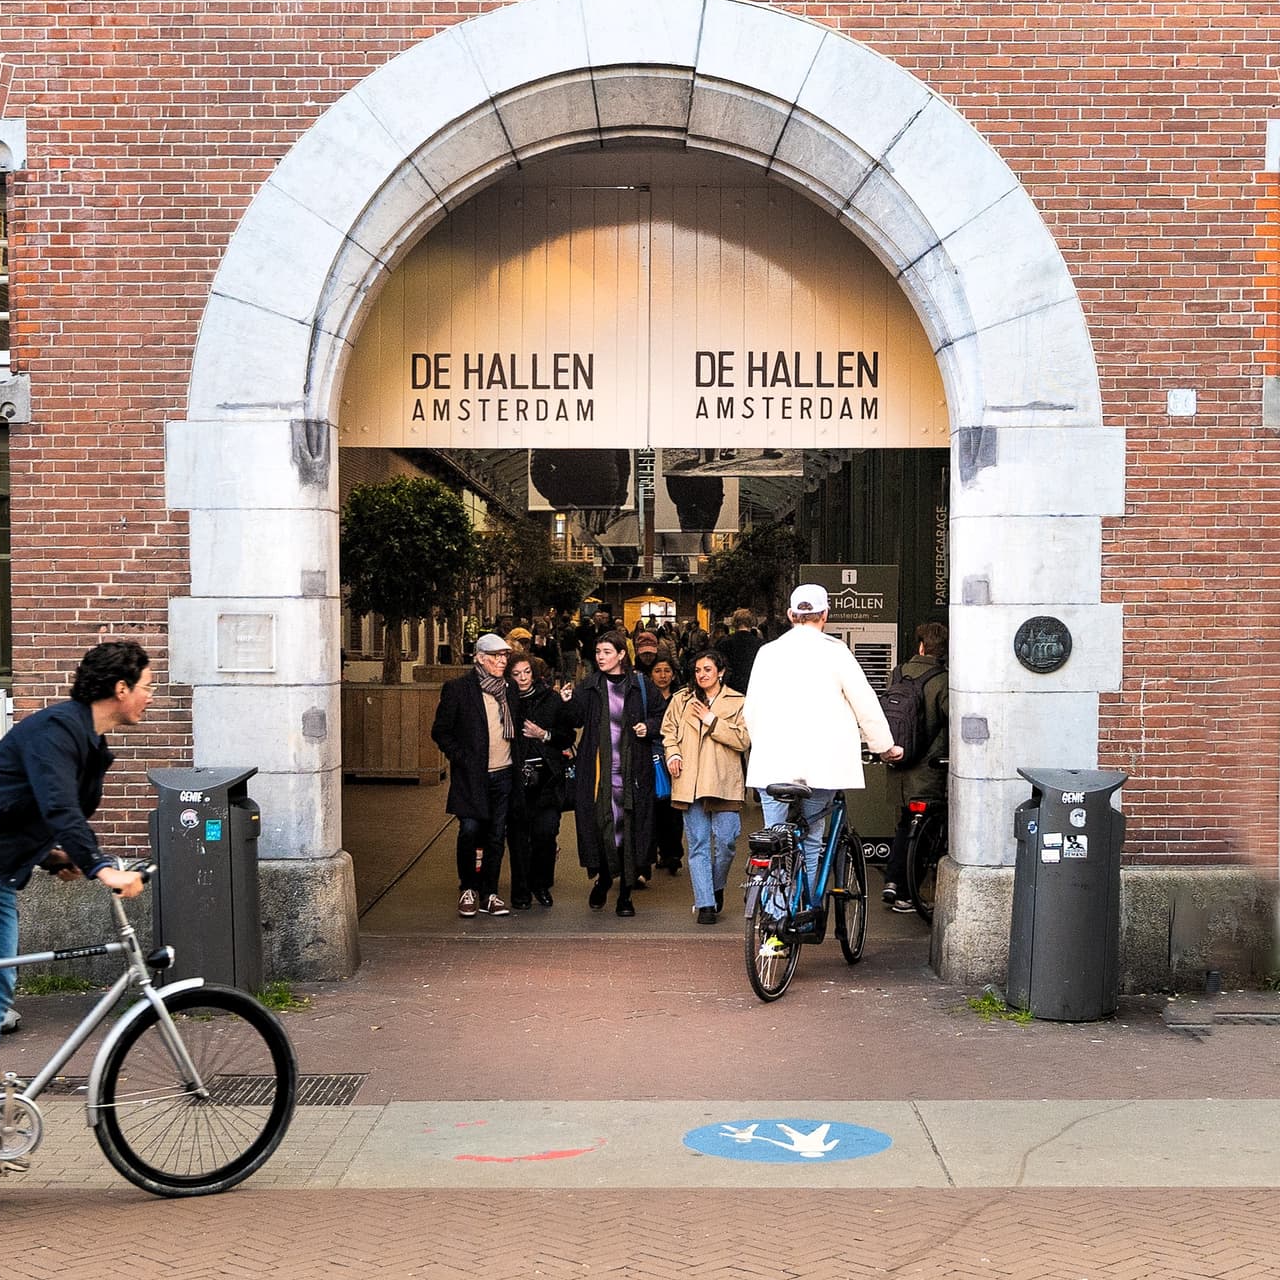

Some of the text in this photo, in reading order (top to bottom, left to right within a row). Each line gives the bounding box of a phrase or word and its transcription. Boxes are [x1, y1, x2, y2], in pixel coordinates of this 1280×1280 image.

[411, 353, 594, 390] DE HALLEN
[695, 351, 879, 388] DE HALLEN
[412, 398, 594, 422] AMSTERDAM
[695, 396, 878, 420] AMSTERDAM
[935, 504, 947, 606] PARKEERGARAGE
[835, 596, 883, 609] HALLEN
